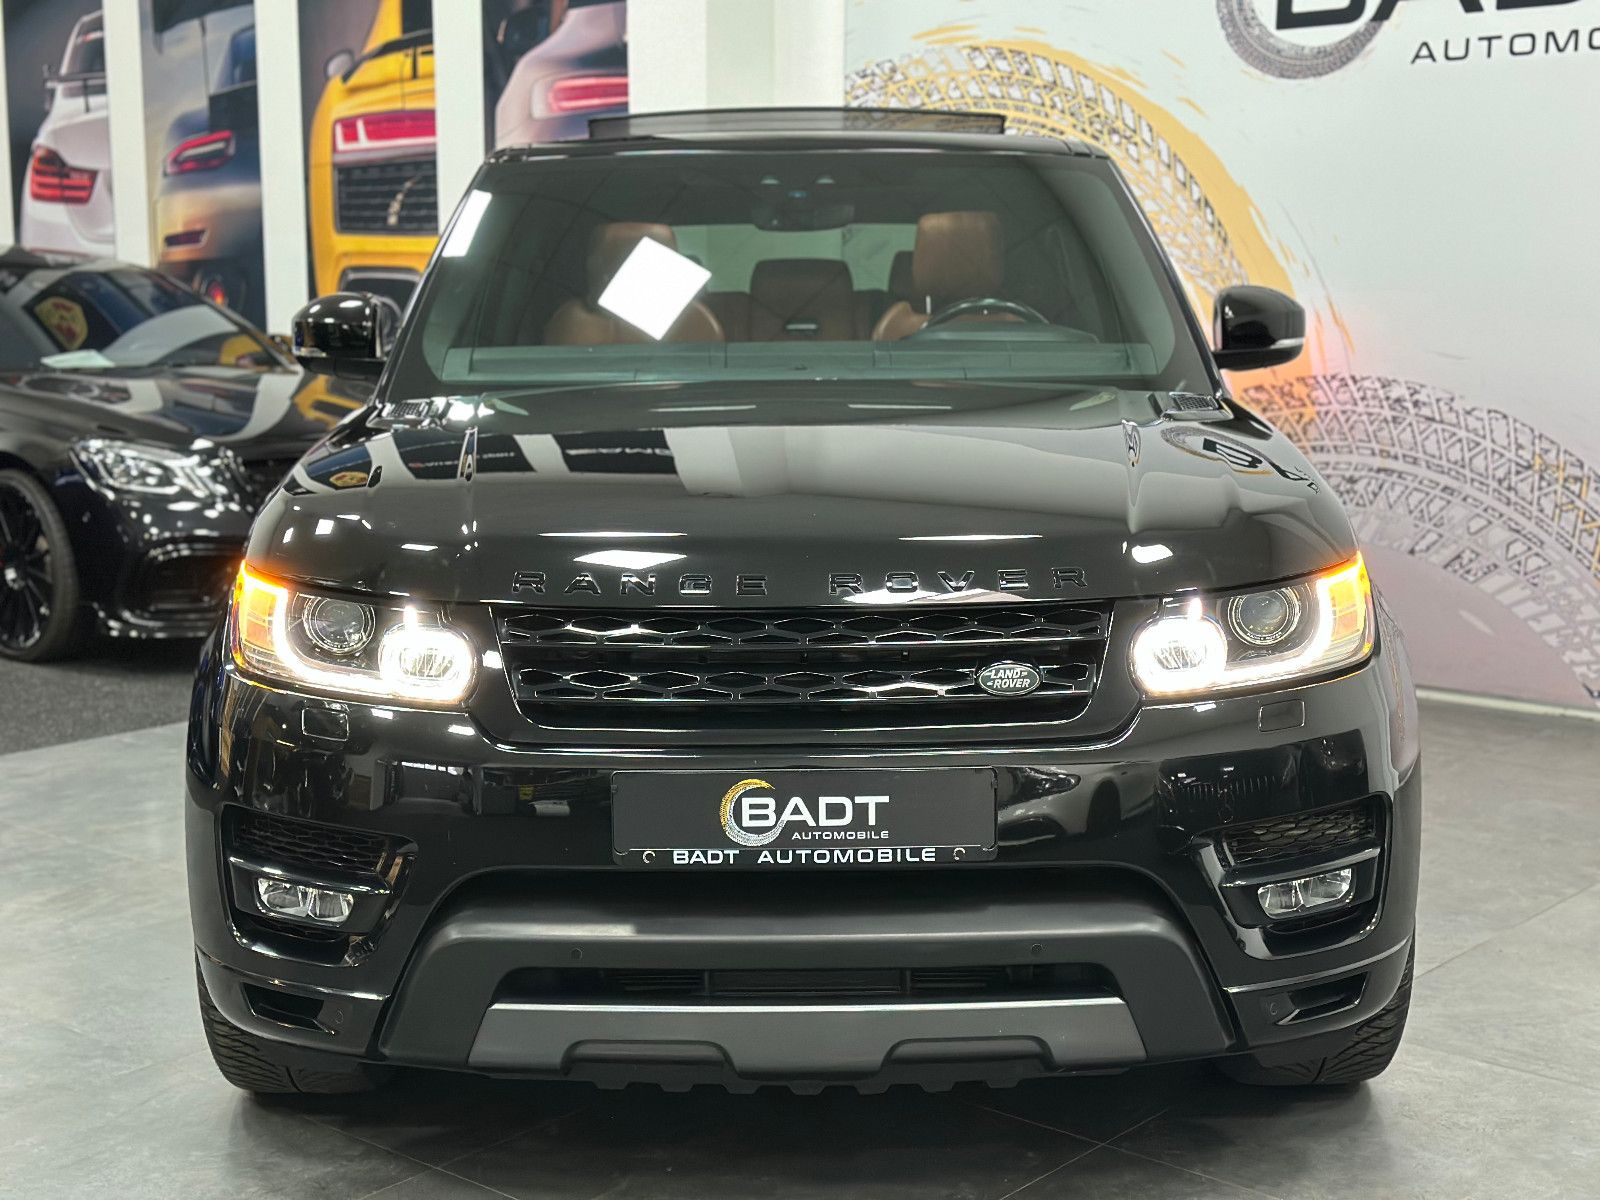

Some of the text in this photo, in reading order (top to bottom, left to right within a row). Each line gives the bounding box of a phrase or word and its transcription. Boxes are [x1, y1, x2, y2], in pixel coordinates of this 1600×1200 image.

[511, 567, 1088, 597] RANGE ROVER
[990, 669, 1020, 679] LAND
[993, 678, 1030, 689] ROVER
[741, 796, 889, 828] BADT
[791, 830, 889, 840] AUTOMOBILE
[673, 848, 936, 865] BADT AUTOMOBILE
